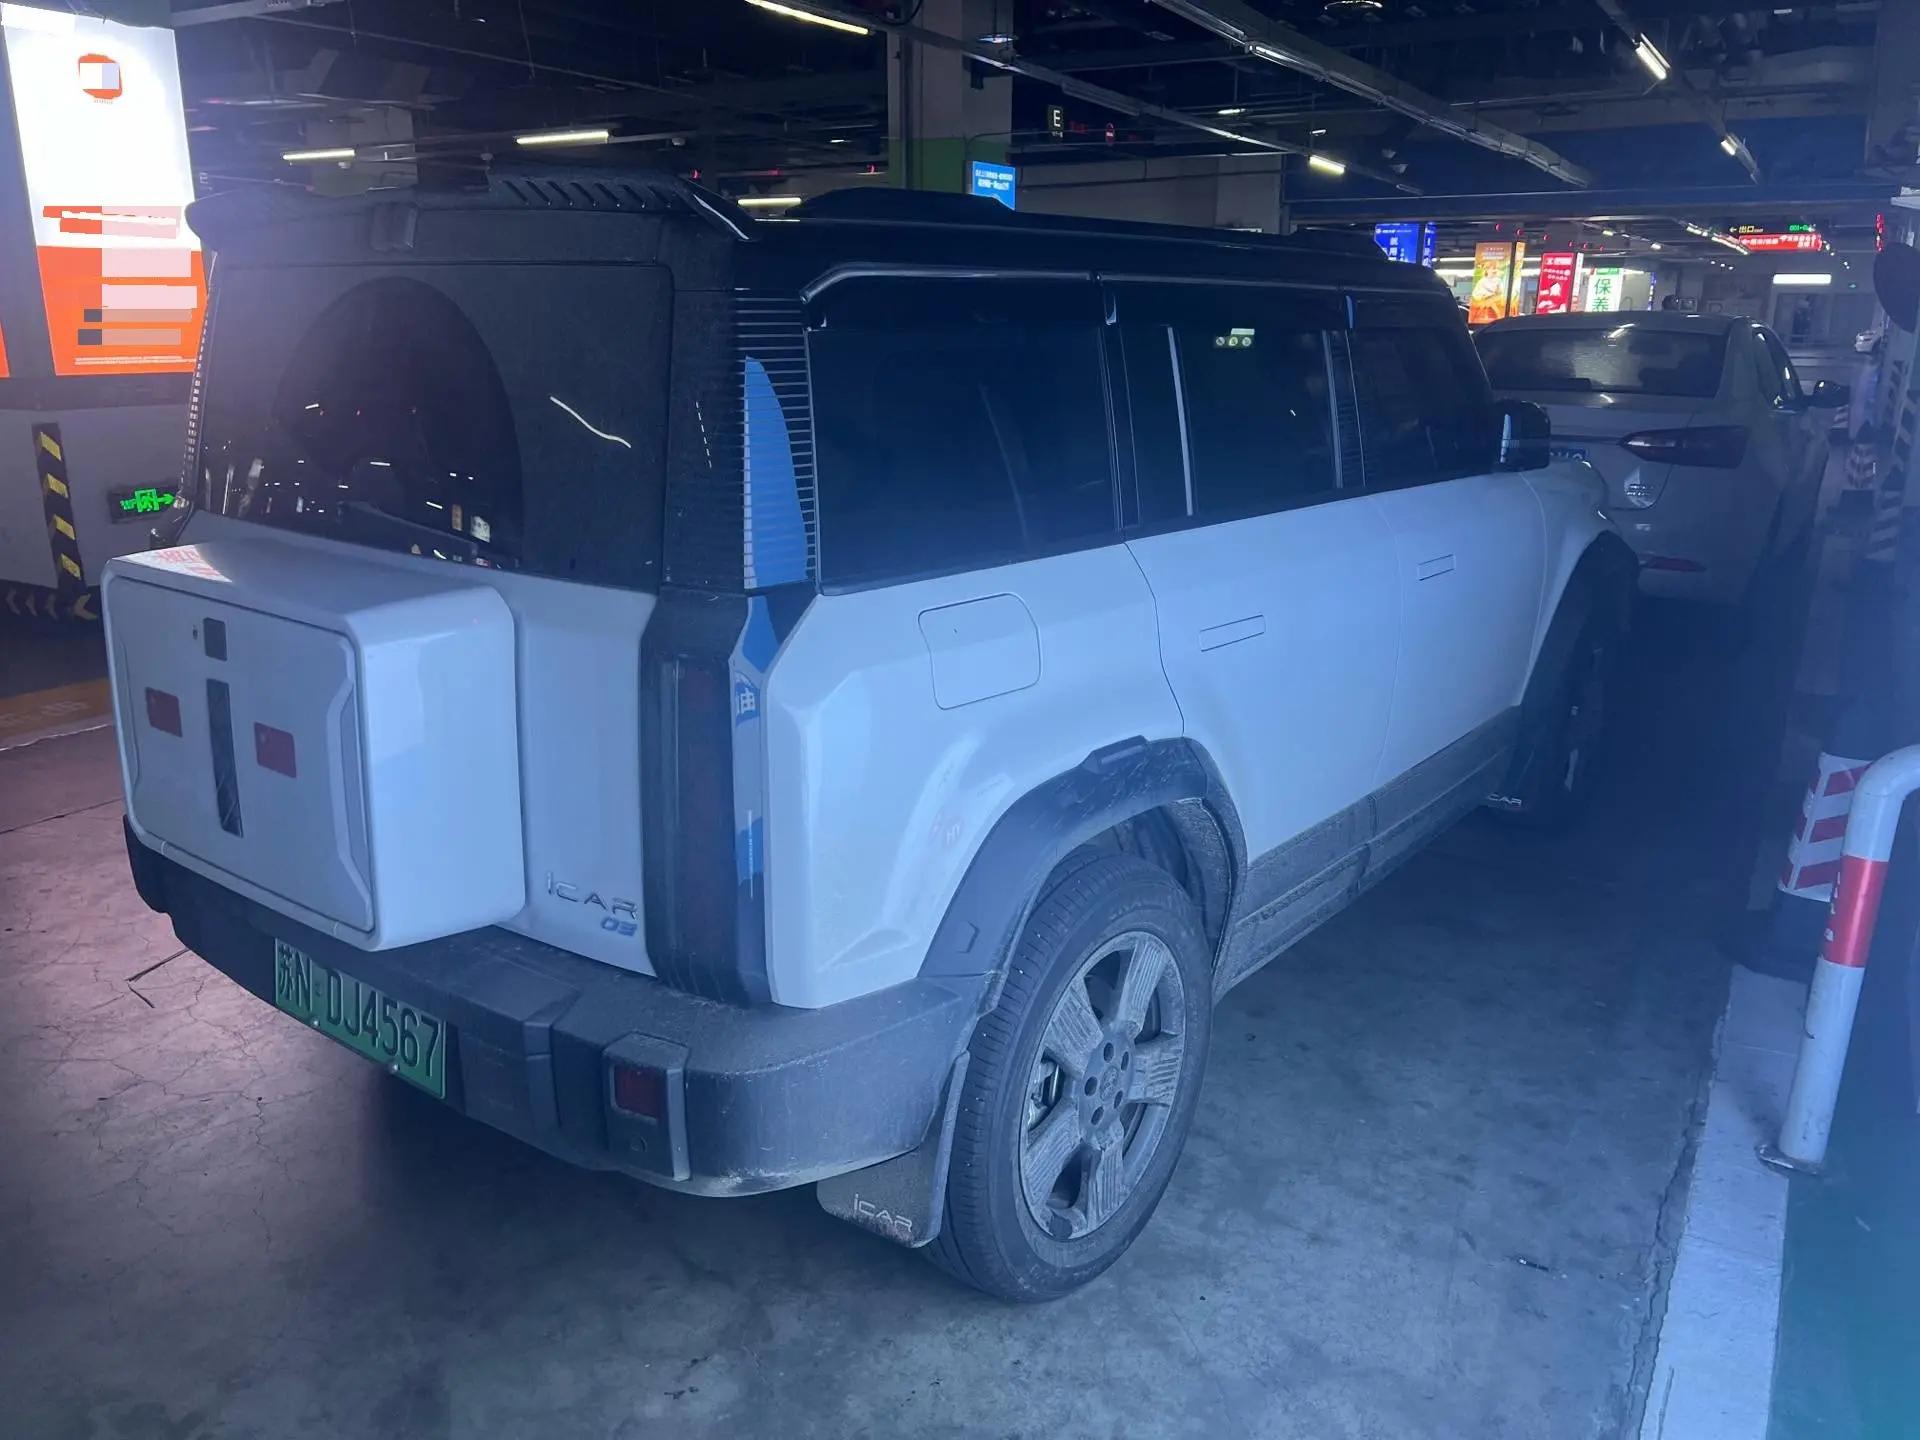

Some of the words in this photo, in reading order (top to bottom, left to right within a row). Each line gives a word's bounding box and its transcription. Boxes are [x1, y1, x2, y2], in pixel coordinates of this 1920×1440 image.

[1053, 109, 1061, 127] E
[1738, 225, 1755, 234] 出口
[1592, 278, 1611, 312] 保养
[601, 916, 638, 937] 03
